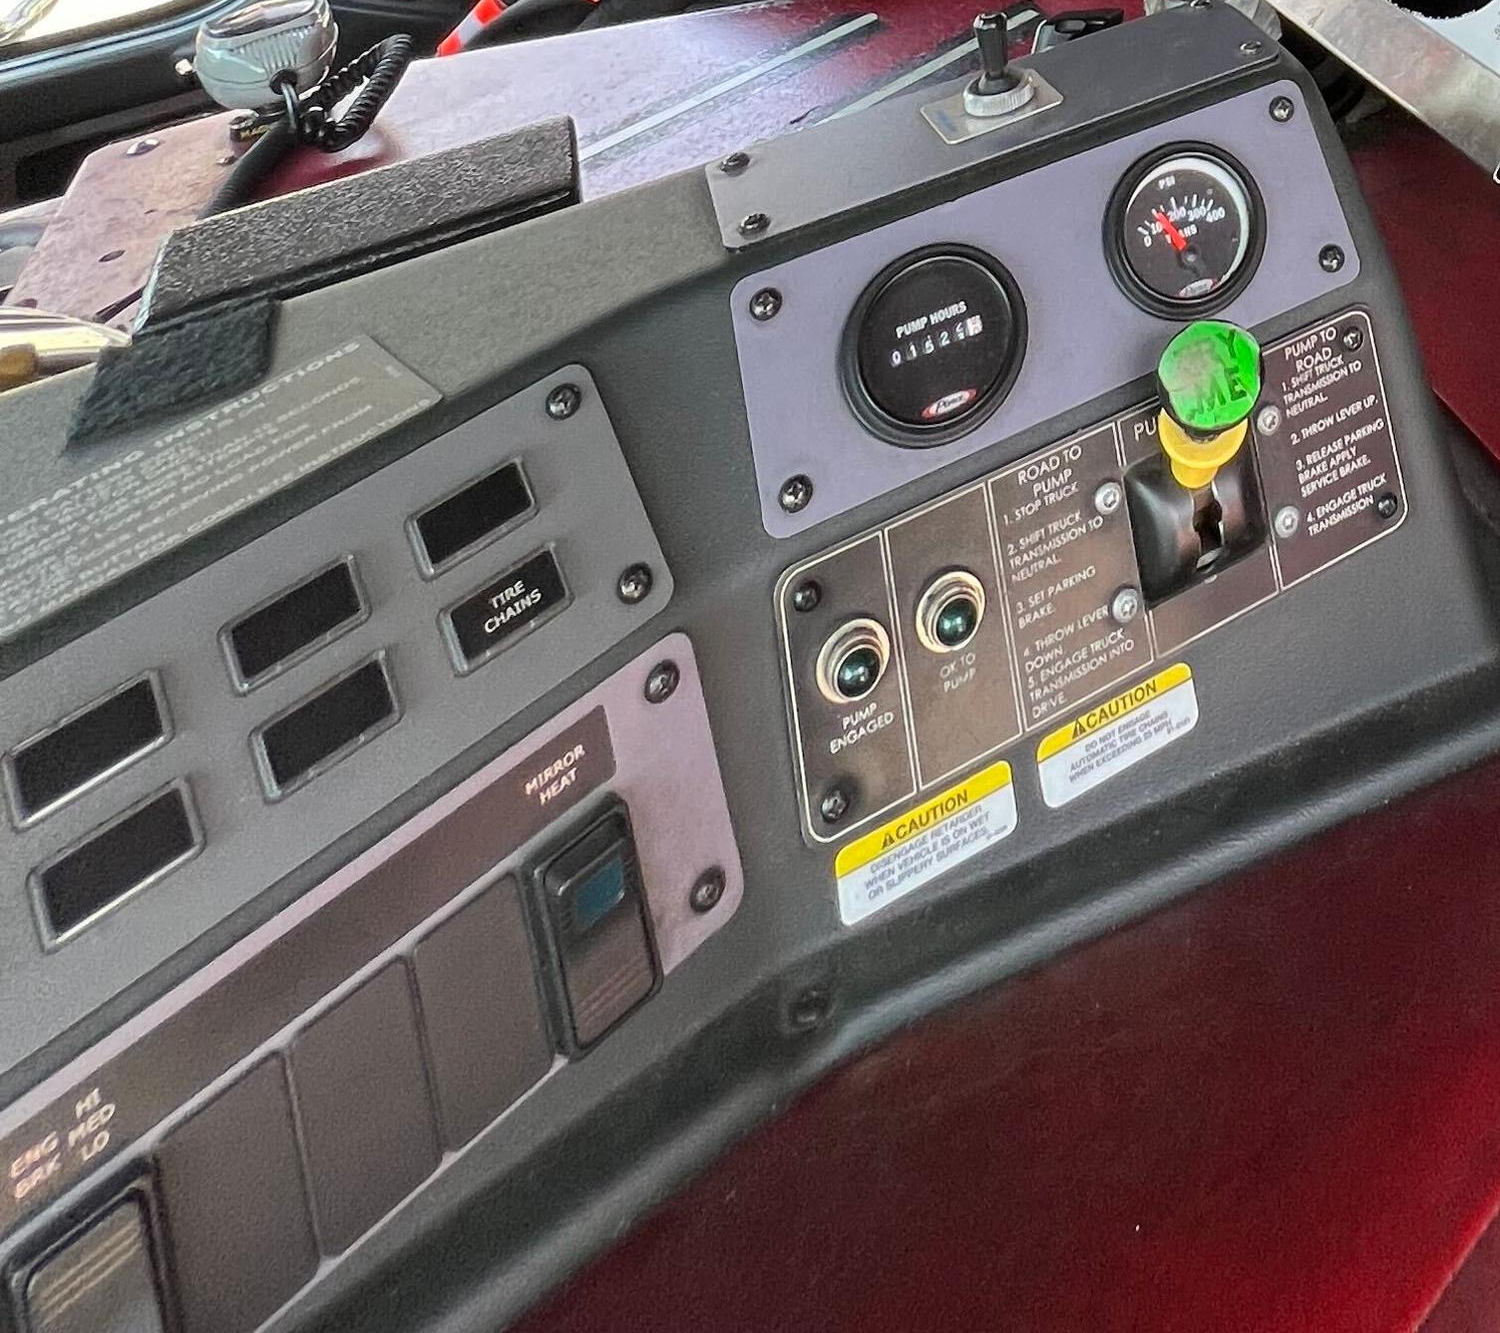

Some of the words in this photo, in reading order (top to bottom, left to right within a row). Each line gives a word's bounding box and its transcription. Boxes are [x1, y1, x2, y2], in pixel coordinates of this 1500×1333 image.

[1158, 176, 1176, 190] PSI
[1151, 222, 1164, 235] 10
[1206, 207, 1226, 223] 400
[896, 316, 928, 339] PUMP
[929, 300, 967, 326] HOURS
[1285, 334, 1318, 361] PUMP
[1316, 326, 1337, 347] TO
[1295, 347, 1332, 373] ROAD
[1283, 368, 1349, 406] TRANSMISSION
[1347, 360, 1362, 375] TO
[1291, 368, 1315, 390] SHIFT
[1314, 354, 1345, 379] TRUCK
[150, 339, 361, 449] INSTRUCTIONS
[1285, 394, 1328, 419] NEUTRAL.
[1134, 418, 1158, 441] PU
[1291, 434, 1301, 446] 2.
[1300, 416, 1336, 441] THROW
[1335, 402, 1364, 427] LEVER
[1362, 394, 1379, 413] UP.
[1018, 457, 1061, 485] ROAD
[1063, 445, 1082, 464] TO
[1296, 460, 1306, 472] 3.
[1305, 439, 1345, 468] RELEASE
[1344, 419, 1385, 451] PARKING
[1299, 461, 1329, 485] BRAKE
[1328, 446, 1358, 472] APPLY
[1033, 468, 1073, 498] PUMP
[1300, 473, 1340, 498] SERVICE
[1339, 454, 1371, 482] BRAKE.
[1003, 514, 1014, 526] 1.
[1014, 499, 1042, 521] STOP
[1044, 482, 1080, 507] TRUCK
[1306, 511, 1317, 523] 4.
[1315, 488, 1357, 520] ENGAGE
[1356, 473, 1387, 499] TRUCK
[1308, 496, 1375, 536] TRANSMISSION
[1007, 544, 1018, 556] 2.
[1019, 527, 1046, 551] SHIFT
[1046, 510, 1083, 535] TRUCK
[1009, 523, 1087, 569] TRANSMISSION
[1088, 515, 1104, 532] TO
[491, 580, 526, 609] TIRE
[1028, 592, 1046, 607] SET
[1047, 565, 1097, 598] PARKING
[484, 588, 542, 634] CHAINS
[1034, 624, 1074, 652] THROW
[1077, 605, 1110, 629] LEVER
[960, 652, 976, 668] TO
[1025, 645, 1063, 674] DOWN
[1029, 653, 1108, 702] TRANSMISSION
[1109, 639, 1136, 659] INTO
[1040, 647, 1088, 683] ENGAGE
[1089, 628, 1126, 655] TRUCK
[943, 667, 976, 693] PUMP
[842, 702, 877, 730] PUMP
[1086, 679, 1158, 730] CAUTION
[829, 711, 895, 754] ENGAGED
[1069, 760, 1094, 783] WHEN
[1153, 719, 1173, 737] MPH
[524, 744, 586, 796] MIRROR
[1070, 741, 1118, 772] AUTOMATIC
[539, 767, 577, 806] HEAT
[895, 790, 969, 839] CAUTION
[864, 868, 896, 891] WHEN
[897, 843, 939, 872] VEHICLE
[941, 834, 951, 846] IS
[952, 824, 968, 841] ON
[968, 811, 990, 831] WET
[870, 835, 928, 874] DISENGAGE
[929, 804, 983, 842] RETARDER
[867, 886, 884, 901] OR
[886, 855, 934, 892] SLIPPERY
[10, 1131, 60, 1179] ENG
[68, 1102, 116, 1148] MED
[81, 1129, 110, 1162] LO
